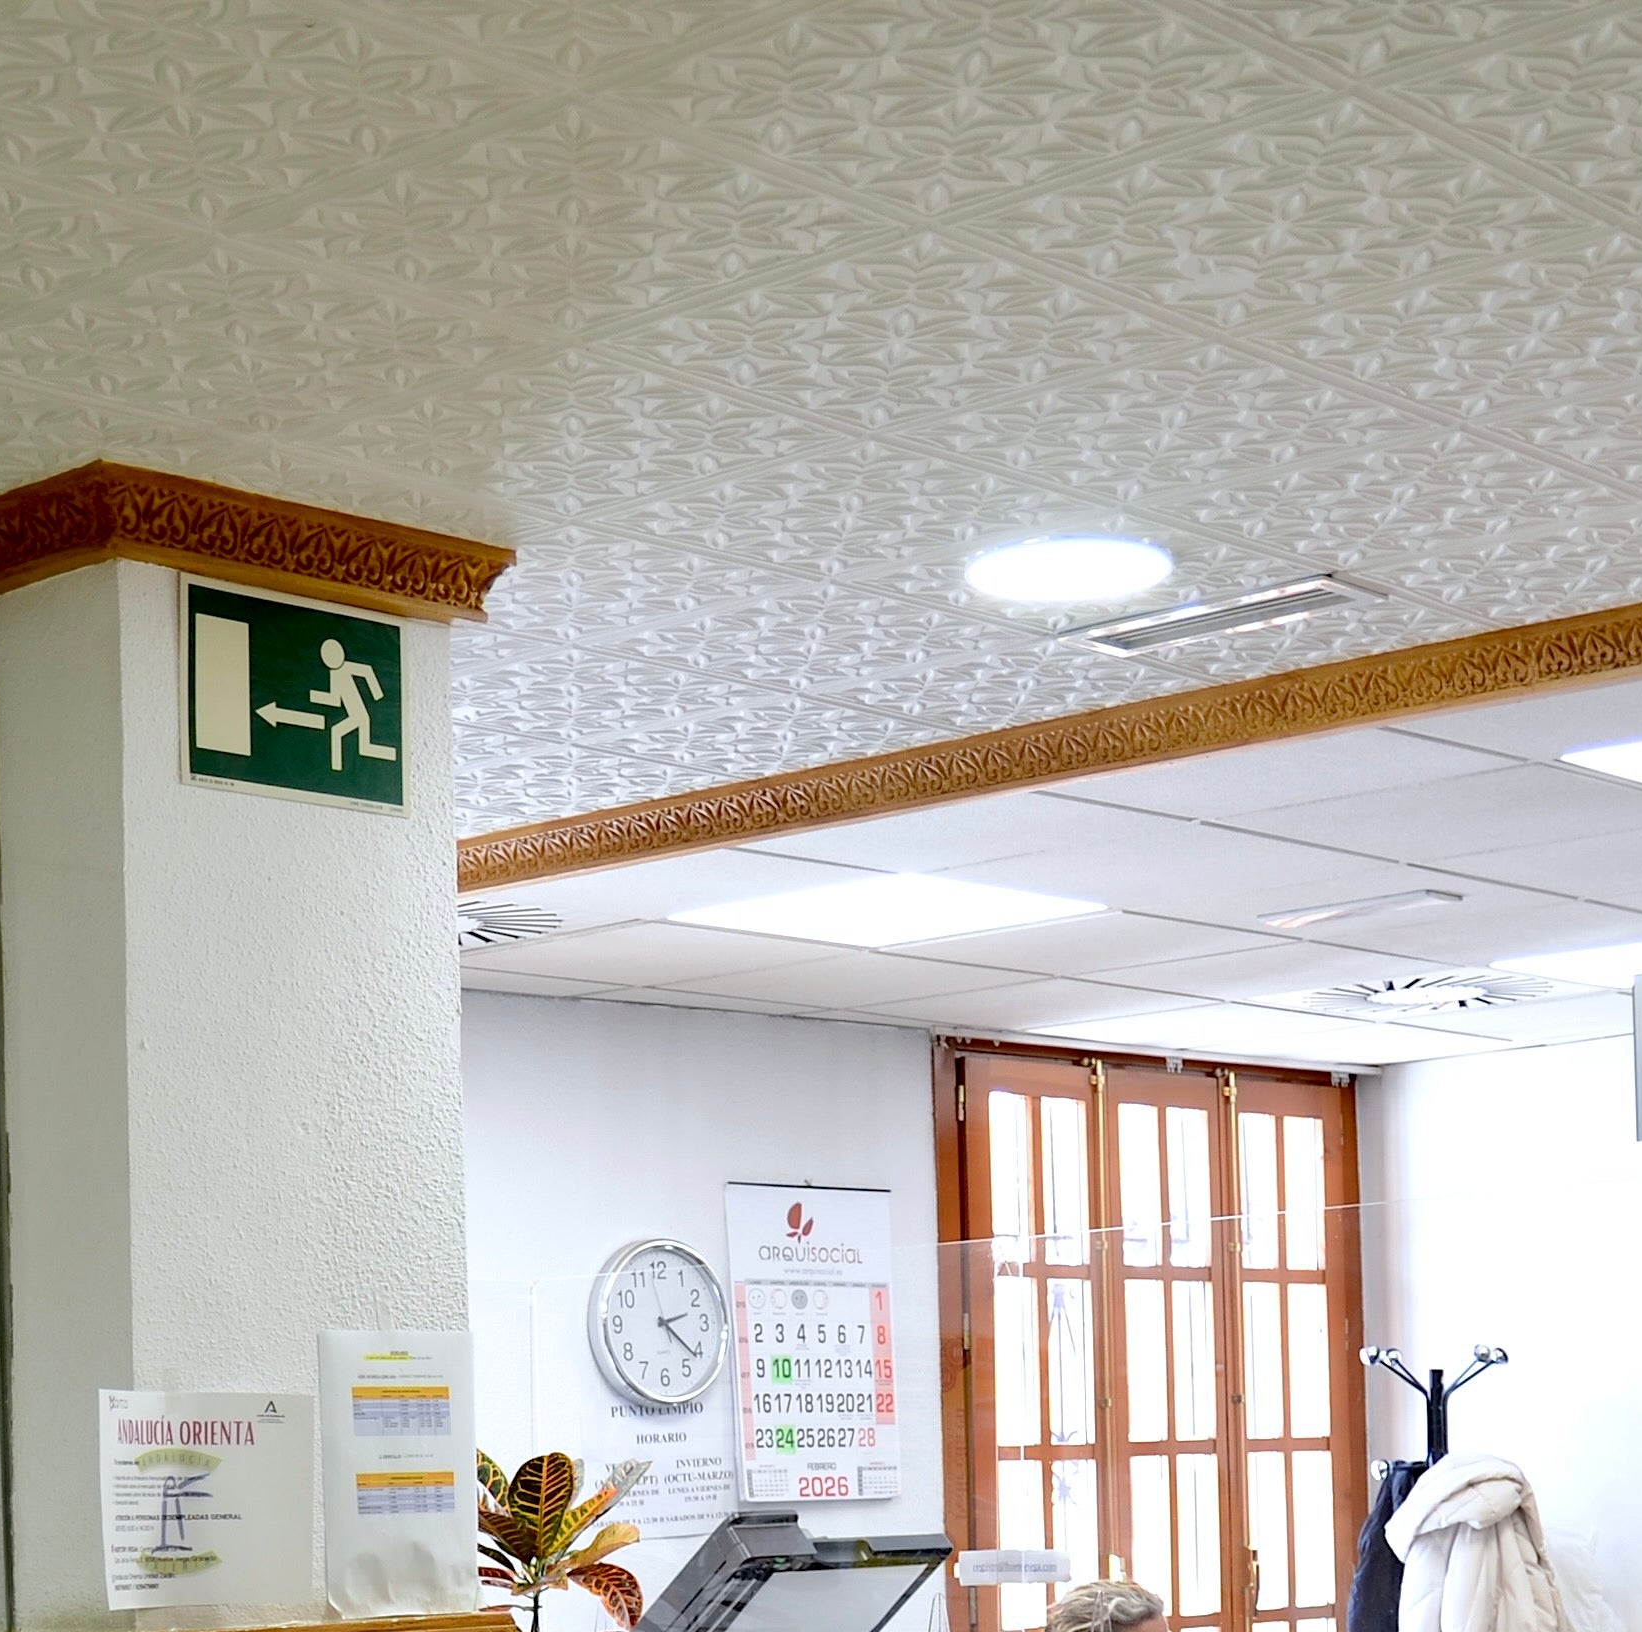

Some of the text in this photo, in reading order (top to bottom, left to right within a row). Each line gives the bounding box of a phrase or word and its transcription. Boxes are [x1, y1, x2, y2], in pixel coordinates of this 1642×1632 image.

[631, 1270, 685, 1289] 11 1
[649, 1260, 667, 1280] 12
[617, 1289, 701, 1309] 10 2
[875, 1290, 883, 1311] 1
[612, 1313, 710, 1334] 9 3
[753, 1322, 887, 1345] 2 3 4 5 6 7 8
[622, 1341, 704, 1361] 8 4
[638, 1358, 692, 1380] 7 5
[659, 1368, 671, 1387] 6
[756, 1357, 893, 1379] 9 10 11 12 13 14 15
[610, 1403, 655, 1418] PUNTO
[753, 1393, 894, 1414] 16 17 18 19 20 21 22
[117, 1415, 255, 1446] ANDALUCÍA ORIENTA
[636, 1431, 687, 1445] HORARIO
[755, 1427, 876, 1449] 23 24 25 26 27 28
[676, 1457, 722, 1469] INVIERNO
[806, 1462, 837, 1471] FEBRERO
[663, 1470, 734, 1484] (OCTU-MARZO)
[798, 1476, 850, 1497] 2026
